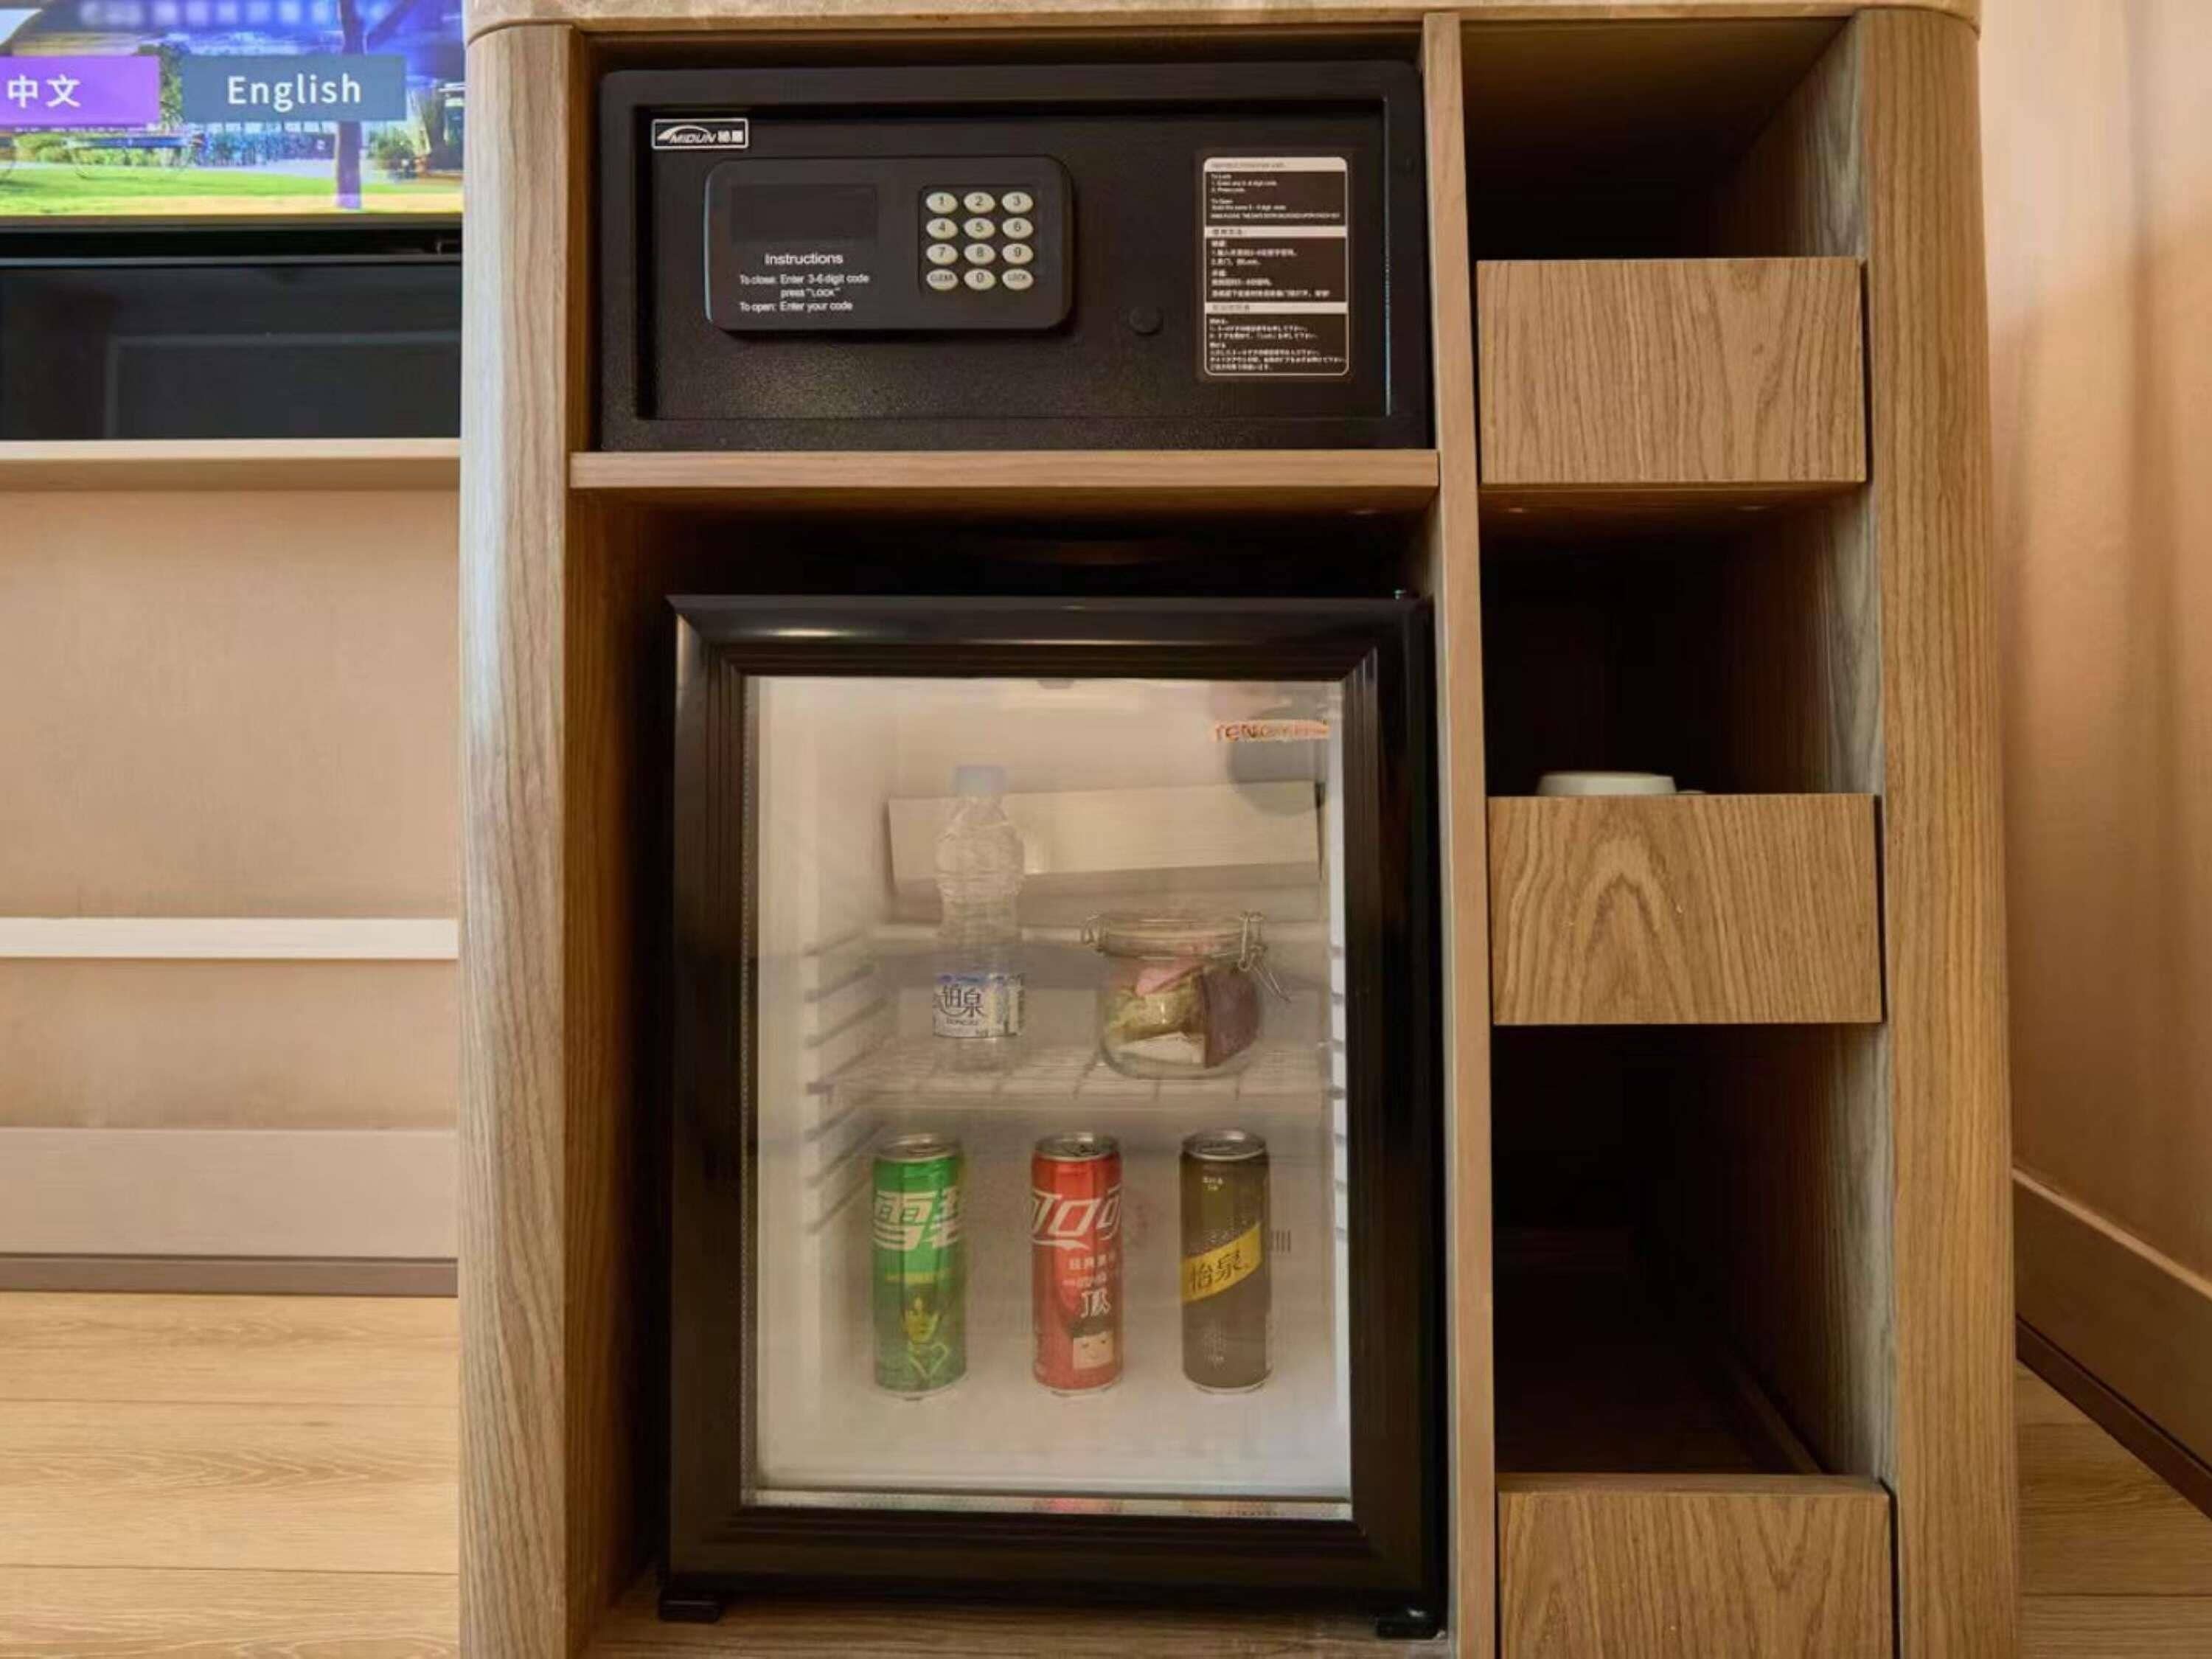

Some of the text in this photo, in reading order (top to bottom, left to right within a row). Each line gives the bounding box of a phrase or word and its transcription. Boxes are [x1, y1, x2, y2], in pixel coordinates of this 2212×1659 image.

[7, 74, 81, 108] 中文
[227, 73, 361, 114] English
[765, 251, 844, 265] Instructions
[740, 274, 750, 285] To
[780, 274, 804, 285] Enter
[846, 273, 870, 284] code
[780, 289, 804, 299] press
[740, 301, 751, 313] To
[780, 301, 804, 312] Enter
[807, 302, 829, 313] your
[830, 301, 854, 312] code
[1190, 1245, 1249, 1295] 怡泉
